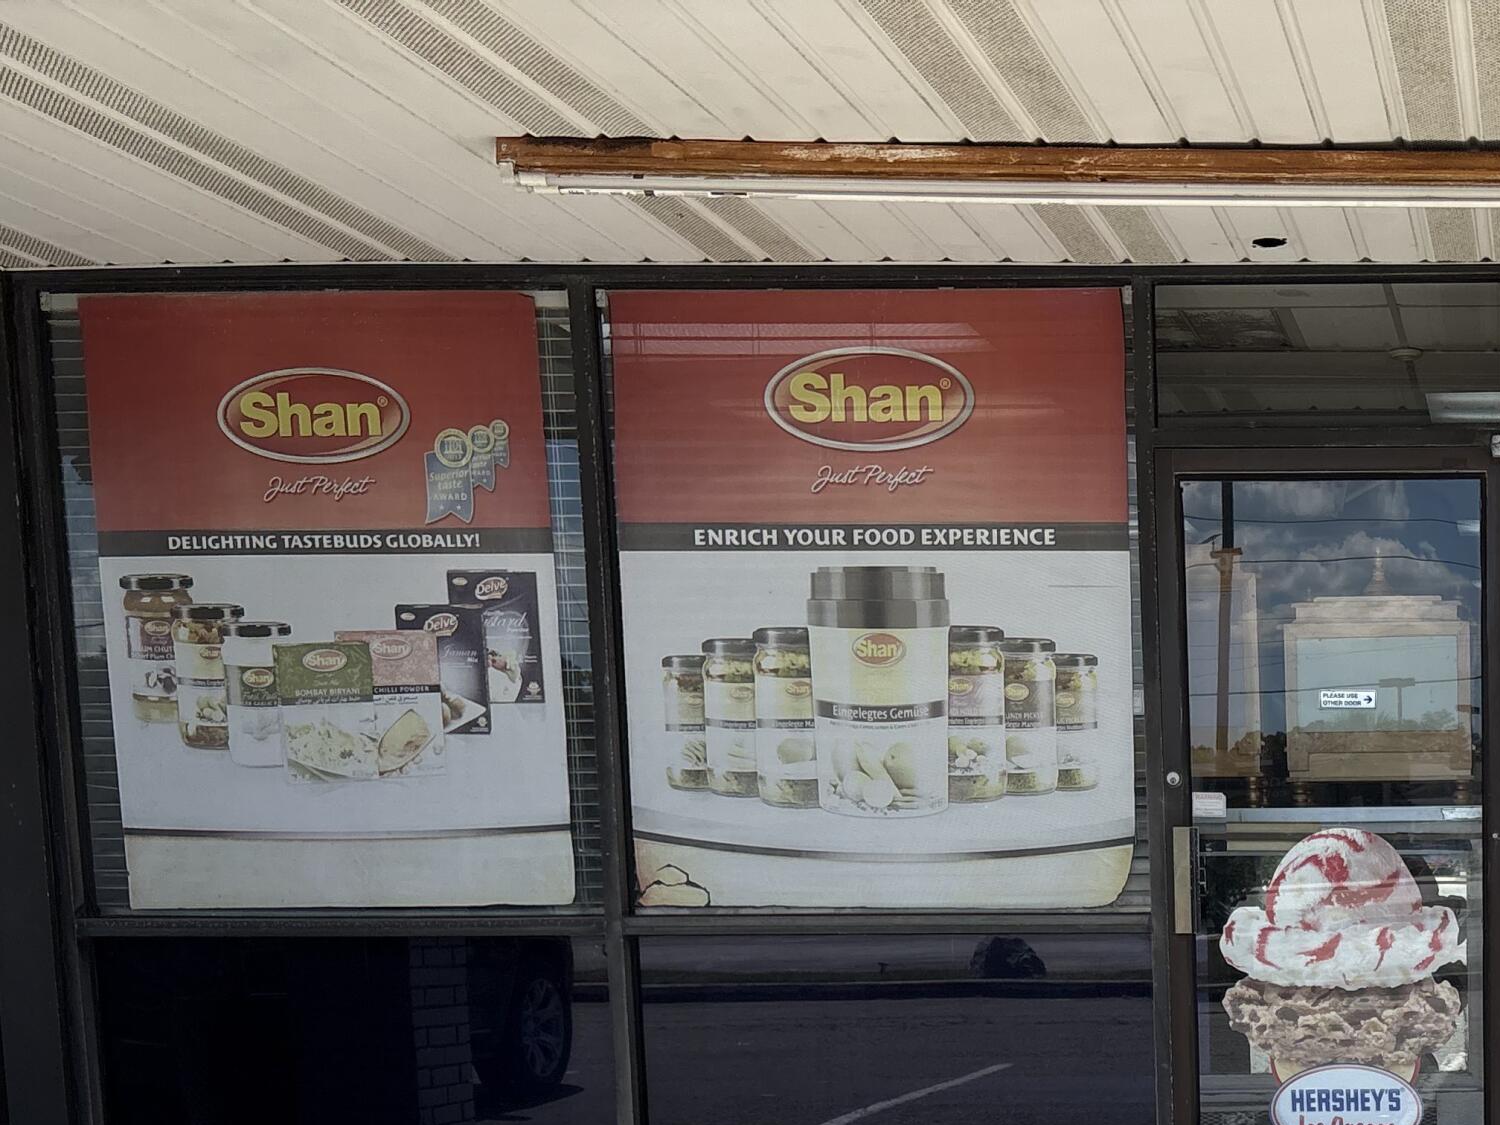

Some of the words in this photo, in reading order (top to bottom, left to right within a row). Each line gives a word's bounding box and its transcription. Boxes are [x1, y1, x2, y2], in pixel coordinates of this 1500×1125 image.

[788, 372, 944, 423] Shan
[239, 391, 383, 438] Shan
[438, 481, 464, 490] taste
[811, 465, 866, 493] Just
[863, 464, 934, 492] Perfect
[263, 476, 312, 502] Just
[311, 475, 376, 501] Perfect
[432, 493, 468, 501] AWARD
[168, 535, 277, 550] DELIGHTING
[281, 534, 381, 548] TASTEBUDS
[386, 533, 480, 548] GLOBALLY!
[694, 529, 778, 545] ENRICH
[783, 528, 846, 545] YOUR
[853, 529, 915, 545] FOOD
[921, 529, 1056, 545] EXPERIENCE
[478, 580, 506, 595] Delve
[426, 617, 457, 631] Delve
[373, 641, 408, 653] Shan
[857, 640, 896, 658] Shan
[304, 655, 344, 666] Shan
[295, 688, 327, 697] BOMBAY
[329, 687, 361, 696] BIRYANI
[399, 685, 430, 693] POWDER
[832, 704, 887, 721] Eingelegtes
[889, 706, 929, 719] Gemüse
[1291, 1088, 1401, 1112] HERSHEY'S
